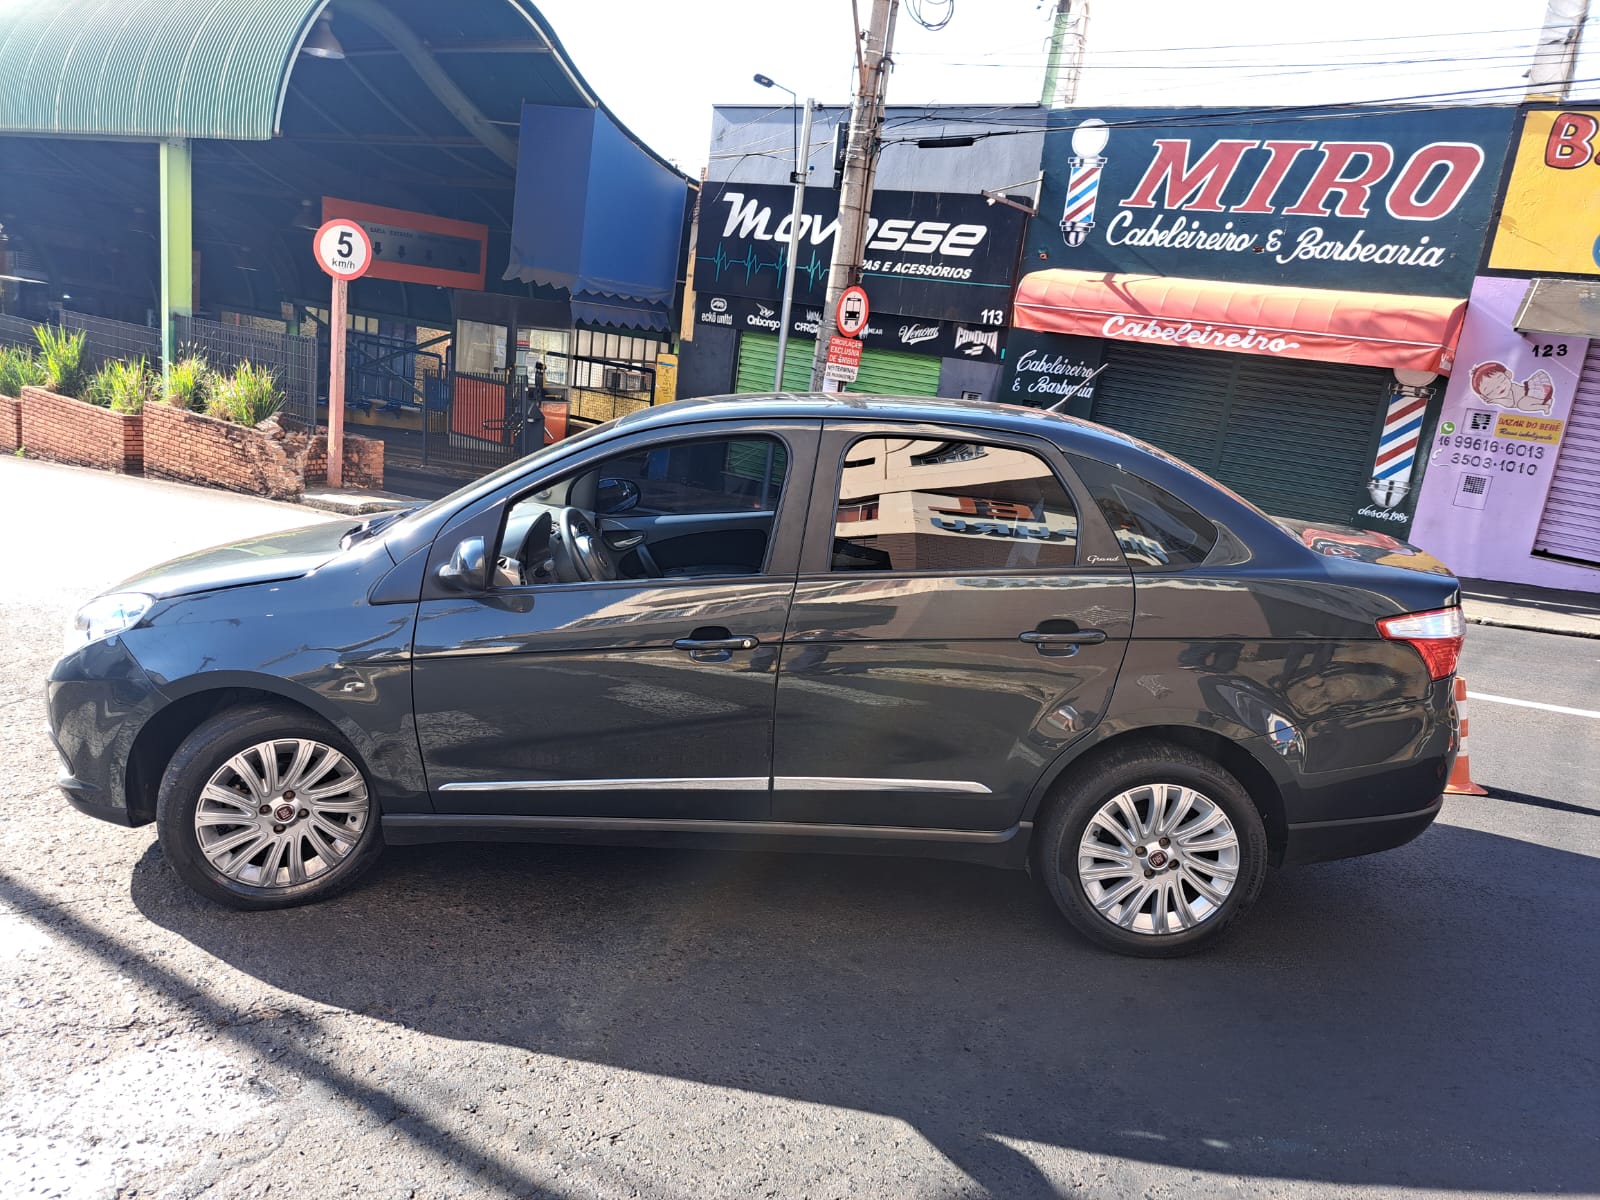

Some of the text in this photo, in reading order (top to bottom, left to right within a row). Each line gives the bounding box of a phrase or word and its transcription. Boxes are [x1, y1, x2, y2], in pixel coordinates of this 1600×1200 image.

[1544, 112, 1600, 170] B
[1119, 139, 1485, 221] MIRO
[336, 231, 353, 258] 5
[1105, 211, 1258, 254] Cabeleireiro
[1276, 226, 1446, 268] Barbearia
[331, 257, 356, 270] km/h
[882, 261, 892, 272] E
[892, 262, 972, 280] ACESSÓRIOS
[747, 314, 780, 331] Onbongo
[981, 309, 1004, 325] 113
[954, 327, 998, 355] CONDUTA
[1102, 315, 1300, 352] Cabeleireiro
[1532, 344, 1568, 357] 123
[1016, 349, 1094, 378] Cabeleireiro
[1027, 376, 1094, 399] Barbearia
[1525, 421, 1538, 429] DO
[1439, 436, 1450, 447] 16
[1357, 504, 1391, 520] desde
[1087, 554, 1120, 564] Grand
